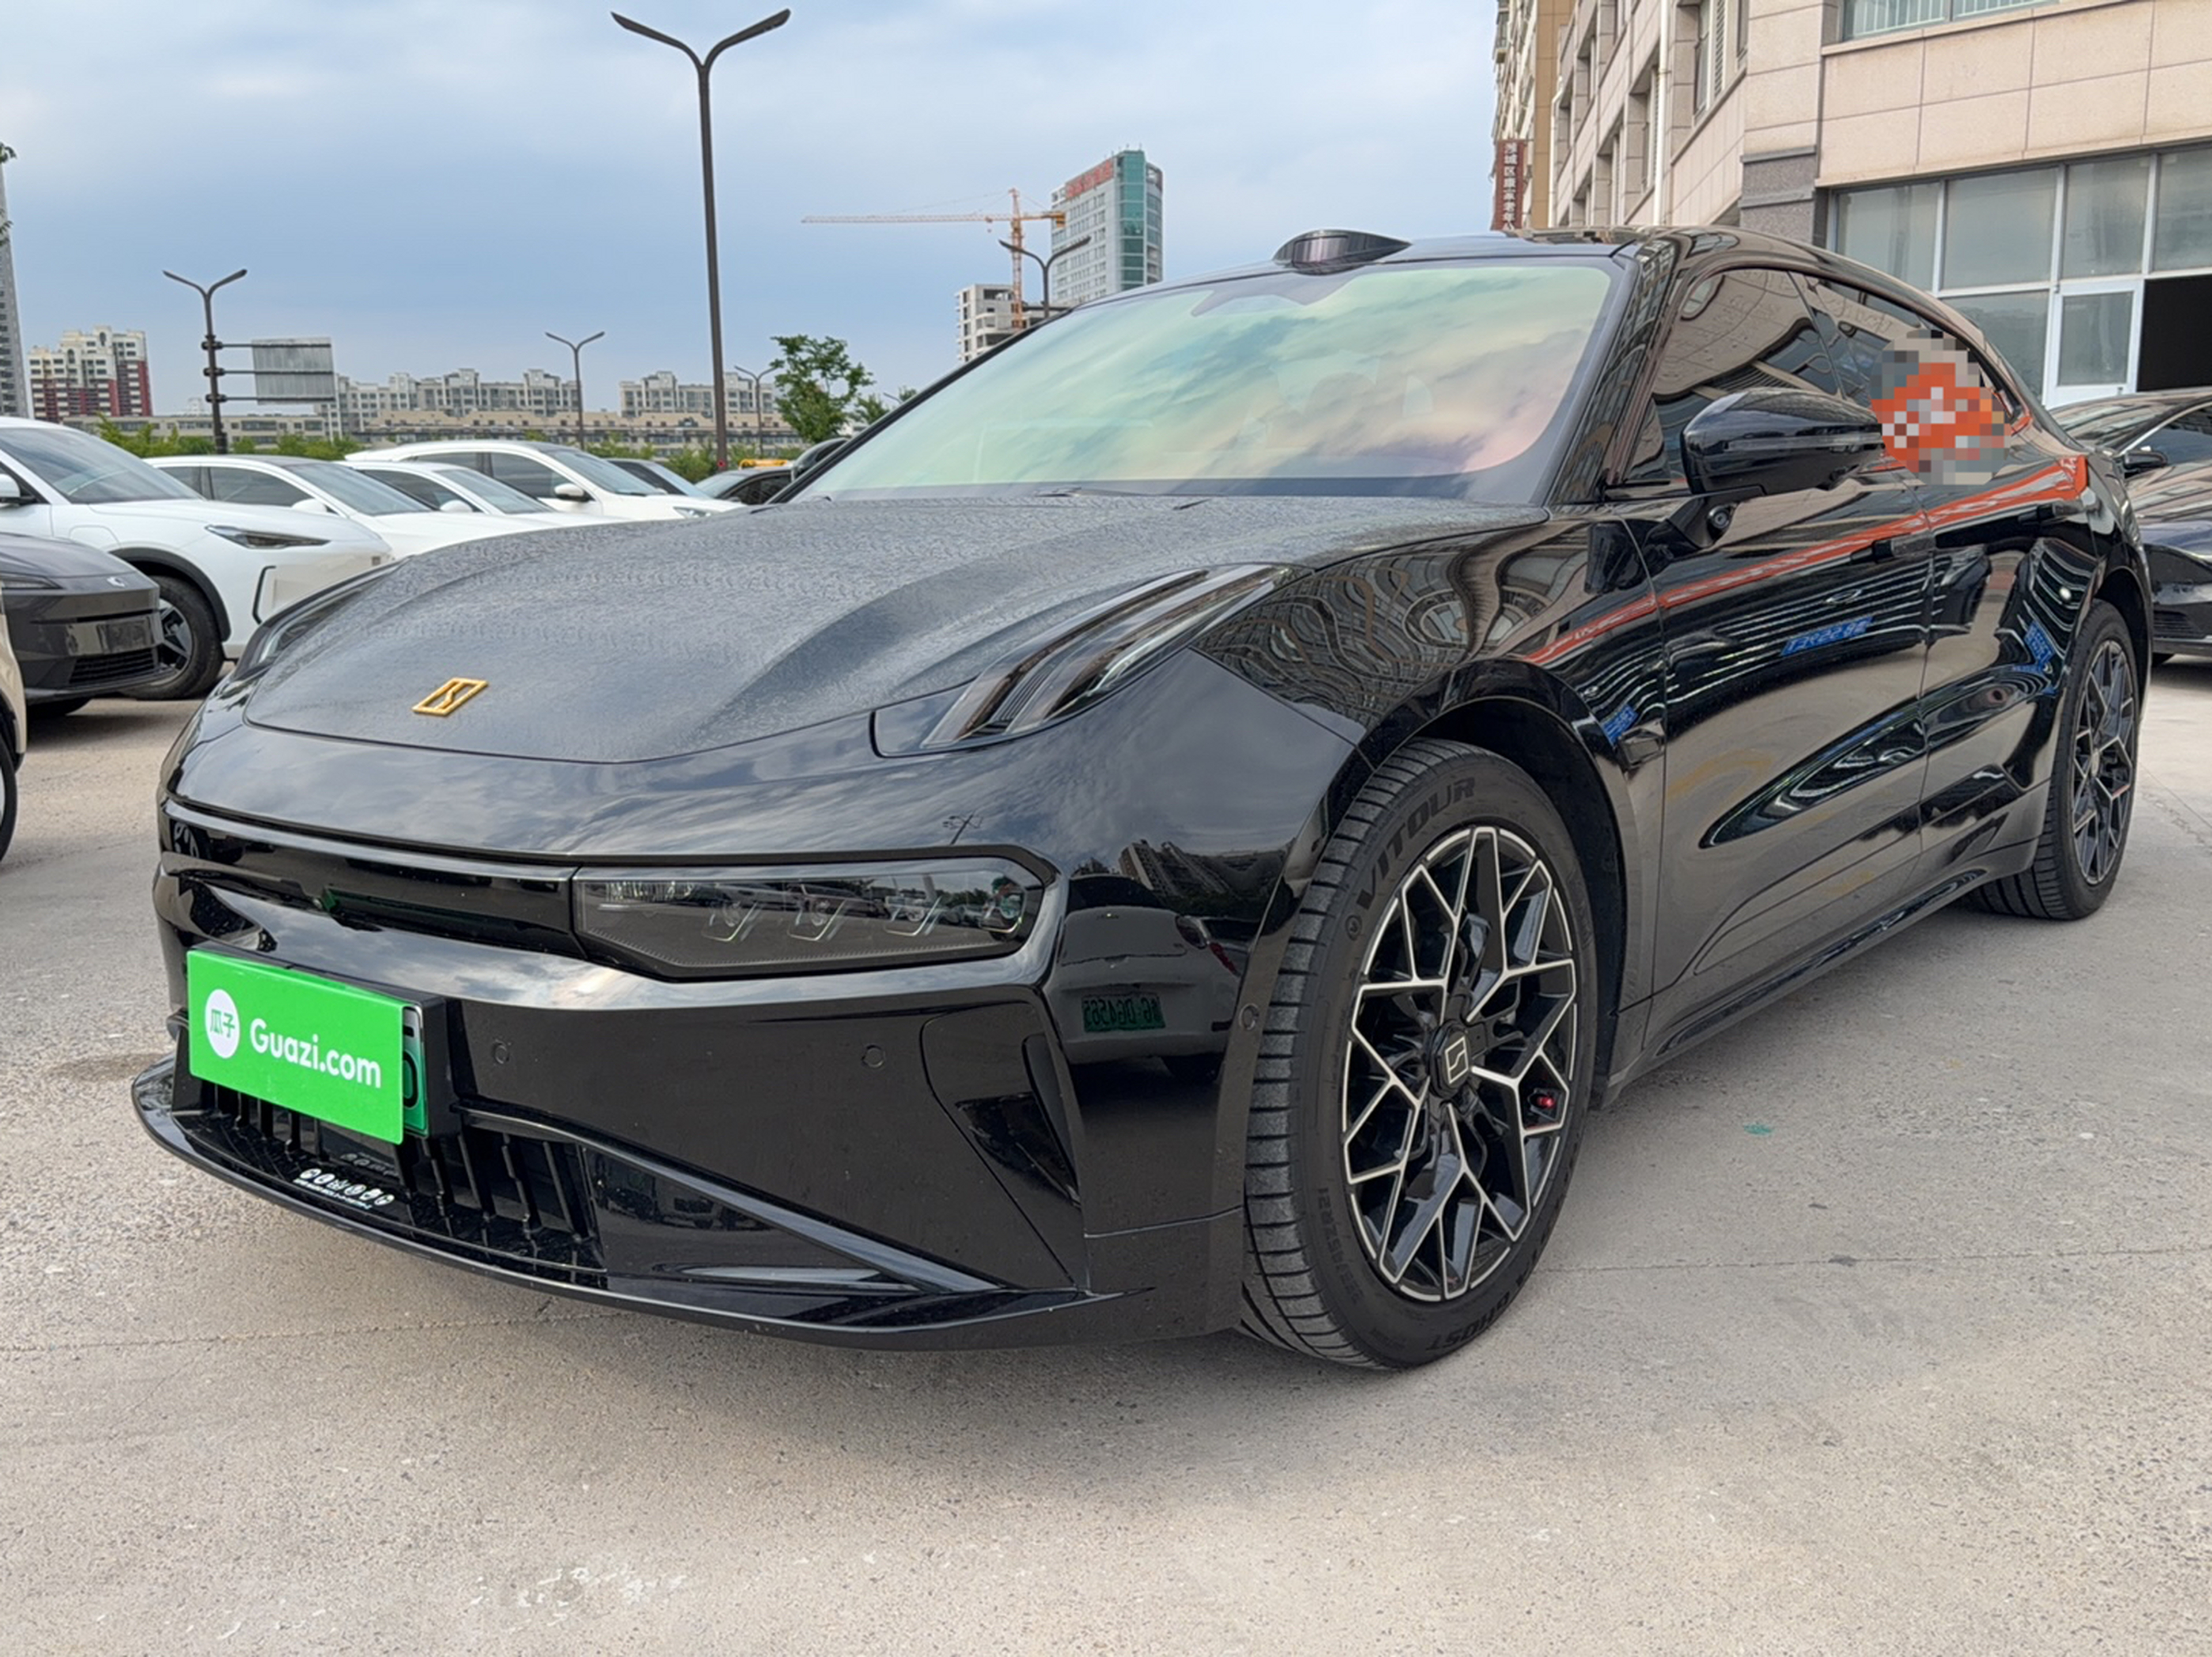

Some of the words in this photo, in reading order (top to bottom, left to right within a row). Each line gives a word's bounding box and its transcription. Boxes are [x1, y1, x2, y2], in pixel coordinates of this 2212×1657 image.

[1357, 777, 1475, 910] VITOUR
[209, 1009, 235, 1038] 瓜子
[250, 1018, 381, 1088] Guazi.com
